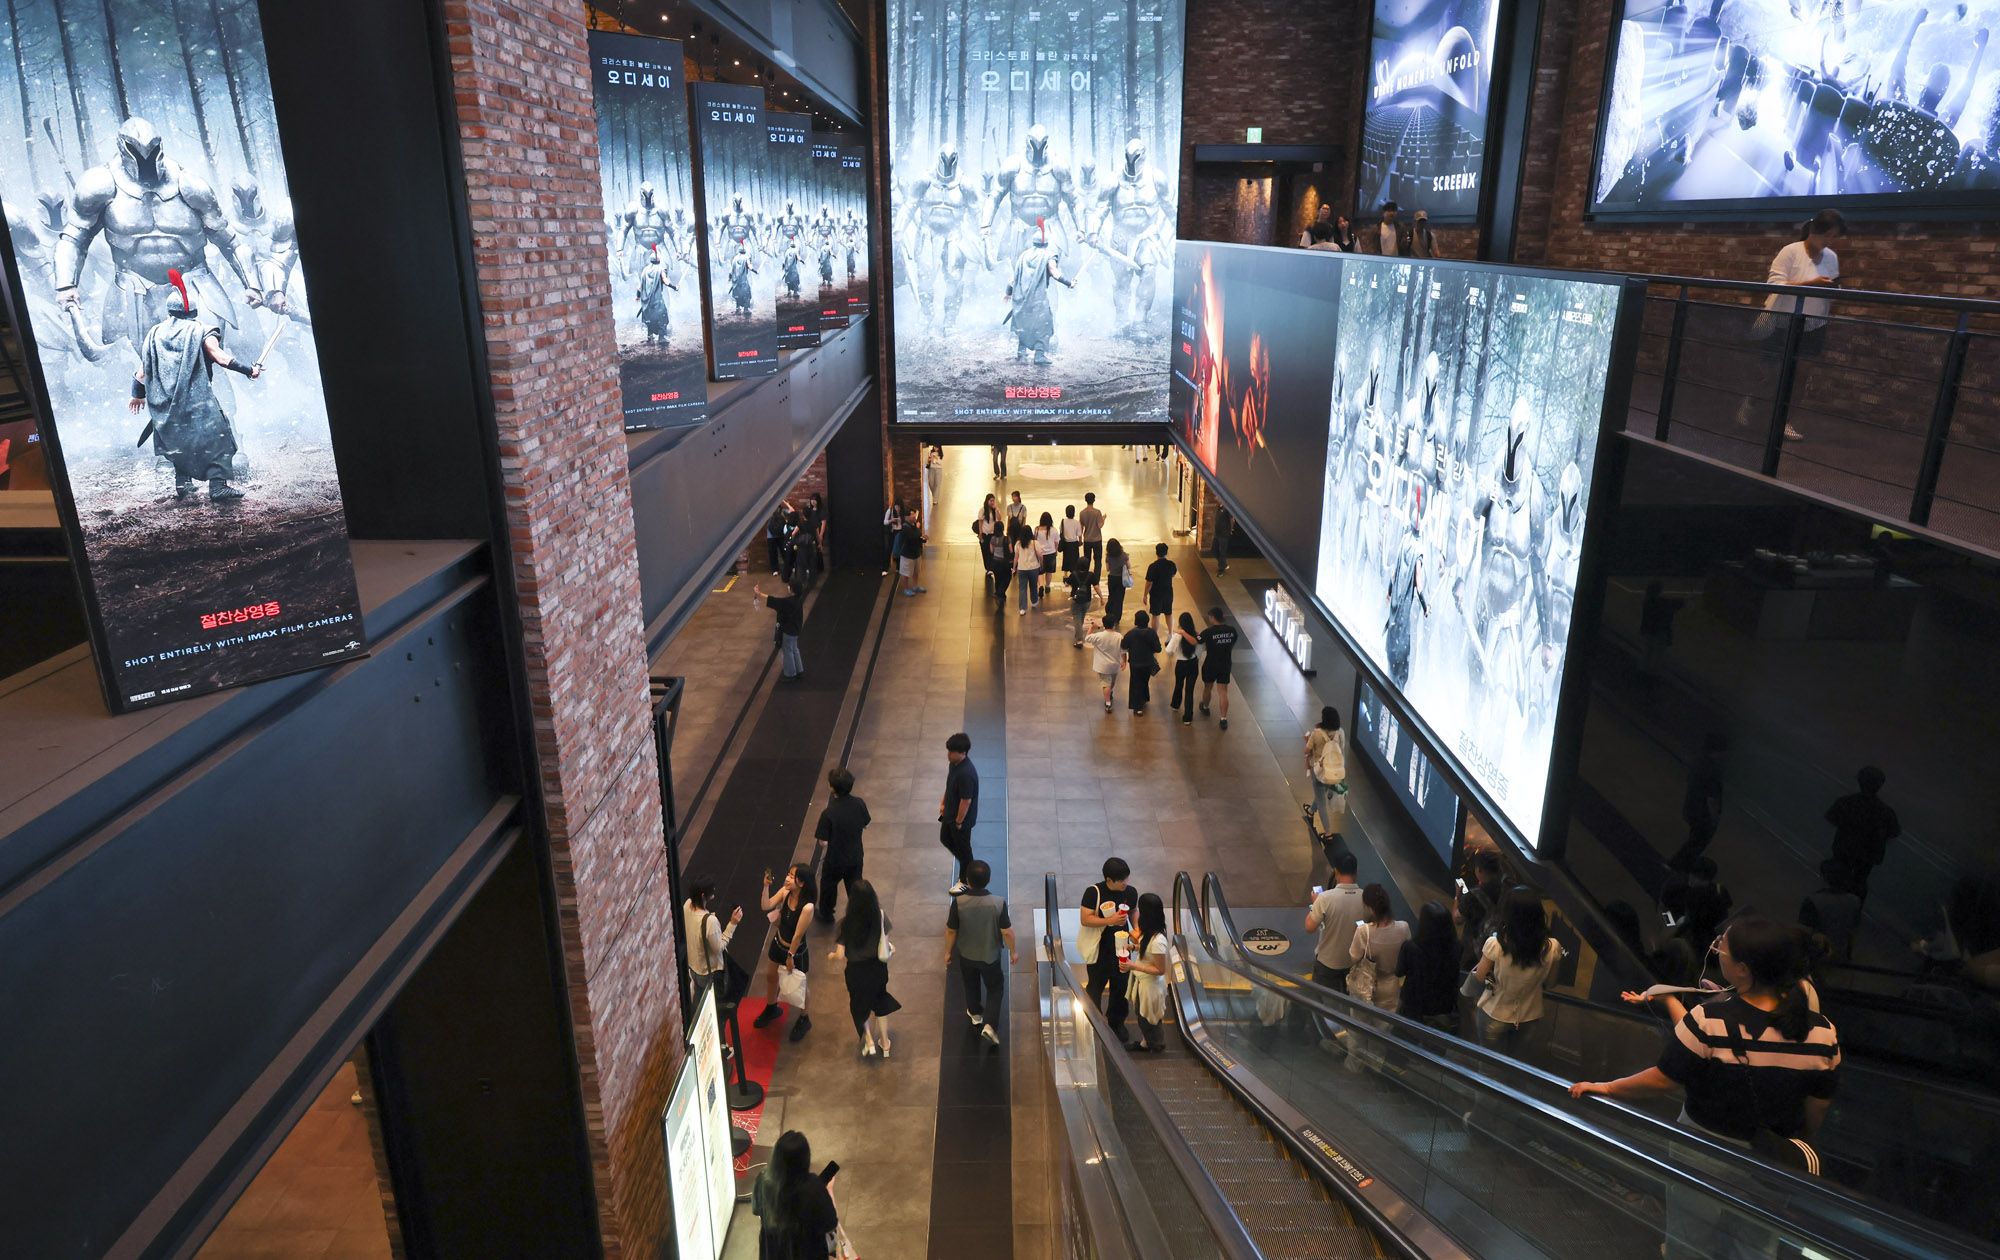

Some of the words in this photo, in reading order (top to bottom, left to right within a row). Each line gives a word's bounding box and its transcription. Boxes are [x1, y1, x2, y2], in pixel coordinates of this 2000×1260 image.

[972, 51, 1029, 61] 크리스토퍼
[1036, 50, 1058, 61] 놀란
[608, 70, 670, 88] 오디세이
[1396, 64, 1435, 91] MOMENTS
[1439, 50, 1480, 75] UNFOLD
[711, 111, 755, 123] 오디세이
[770, 133, 804, 144] 오디세이
[1432, 172, 1477, 192] SCREENX
[1005, 386, 1062, 399] 절찬상영중
[1366, 452, 1486, 577] 오디세이
[200, 601, 281, 630] 절찬상영중
[125, 655, 155, 668] SHOT
[159, 643, 212, 661] ENTIRELY
[216, 636, 244, 648] WITH
[248, 629, 278, 642] IMAX
[281, 623, 304, 634] FILM
[307, 613, 354, 629] CAMERAS
[1264, 589, 1309, 671] 오디세이
[1458, 729, 1509, 801] 절찬상영중
